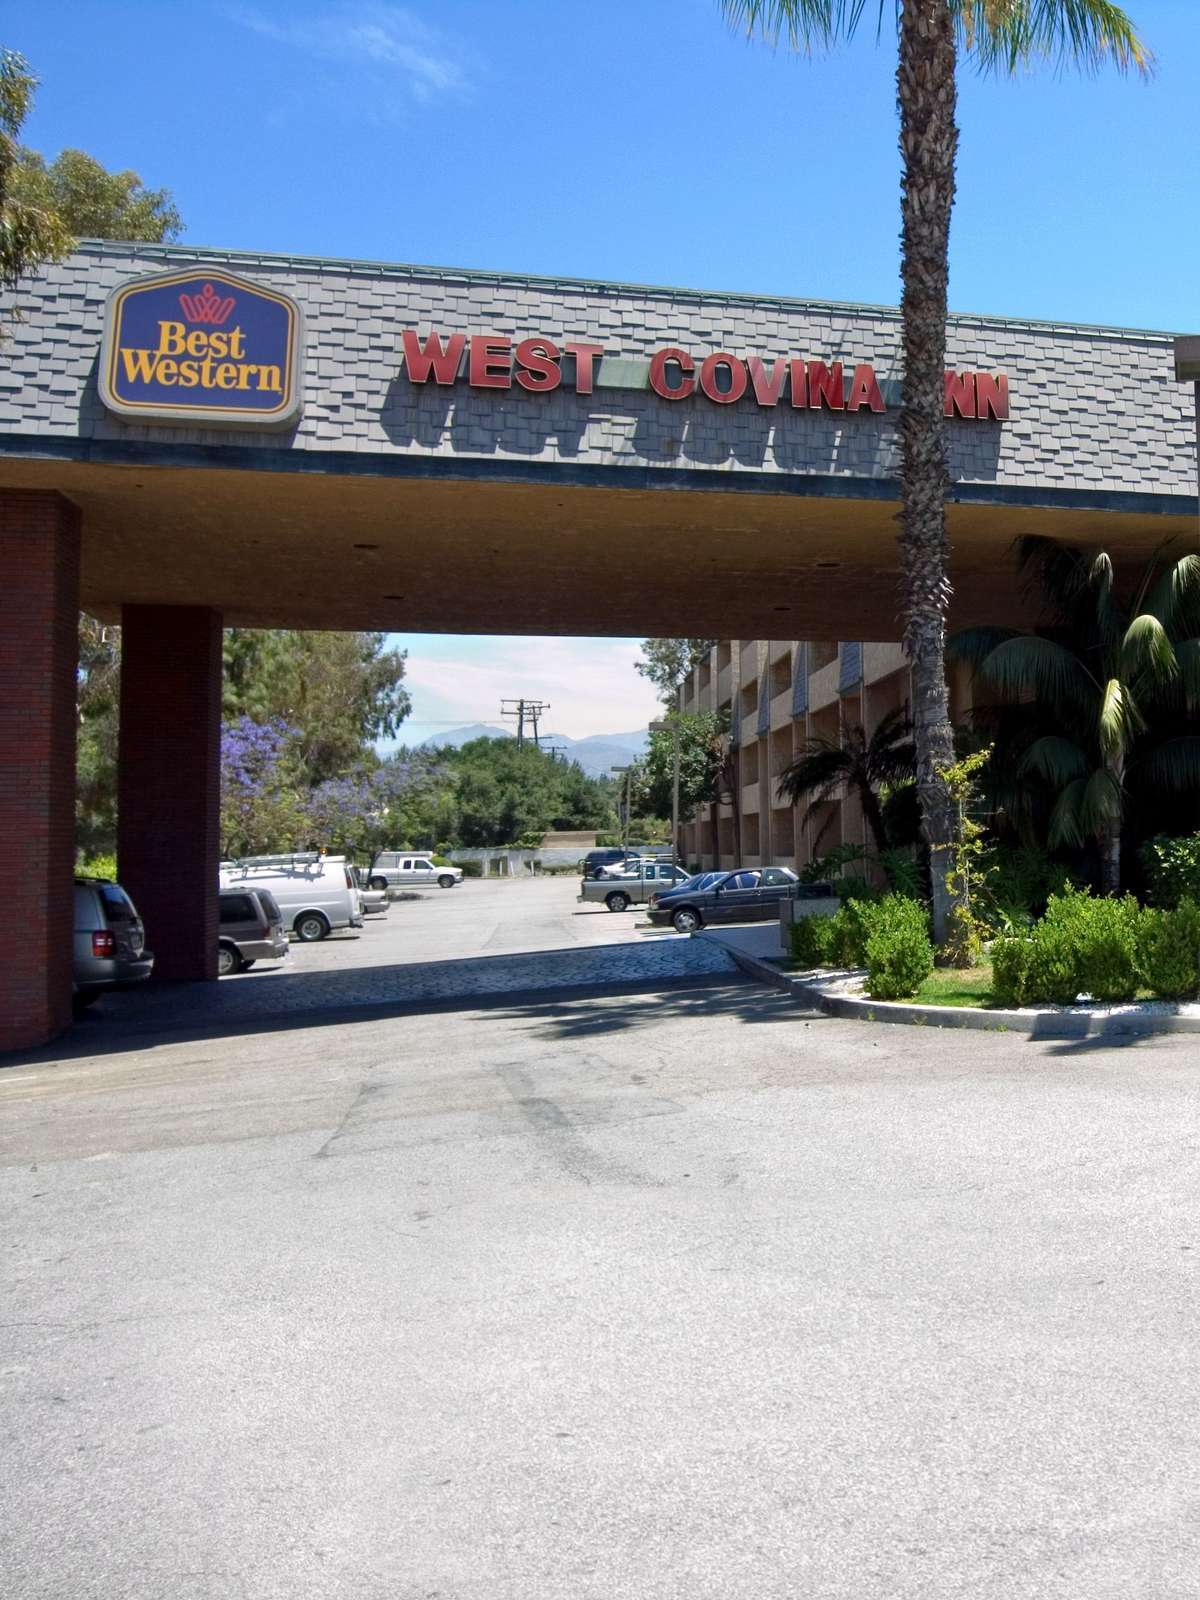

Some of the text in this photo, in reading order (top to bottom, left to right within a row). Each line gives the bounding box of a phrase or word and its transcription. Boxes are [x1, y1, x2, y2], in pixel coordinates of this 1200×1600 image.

[158, 321, 246, 359] Best
[120, 348, 282, 392] Western
[401, 330, 1009, 420] WEST COVINA NN
